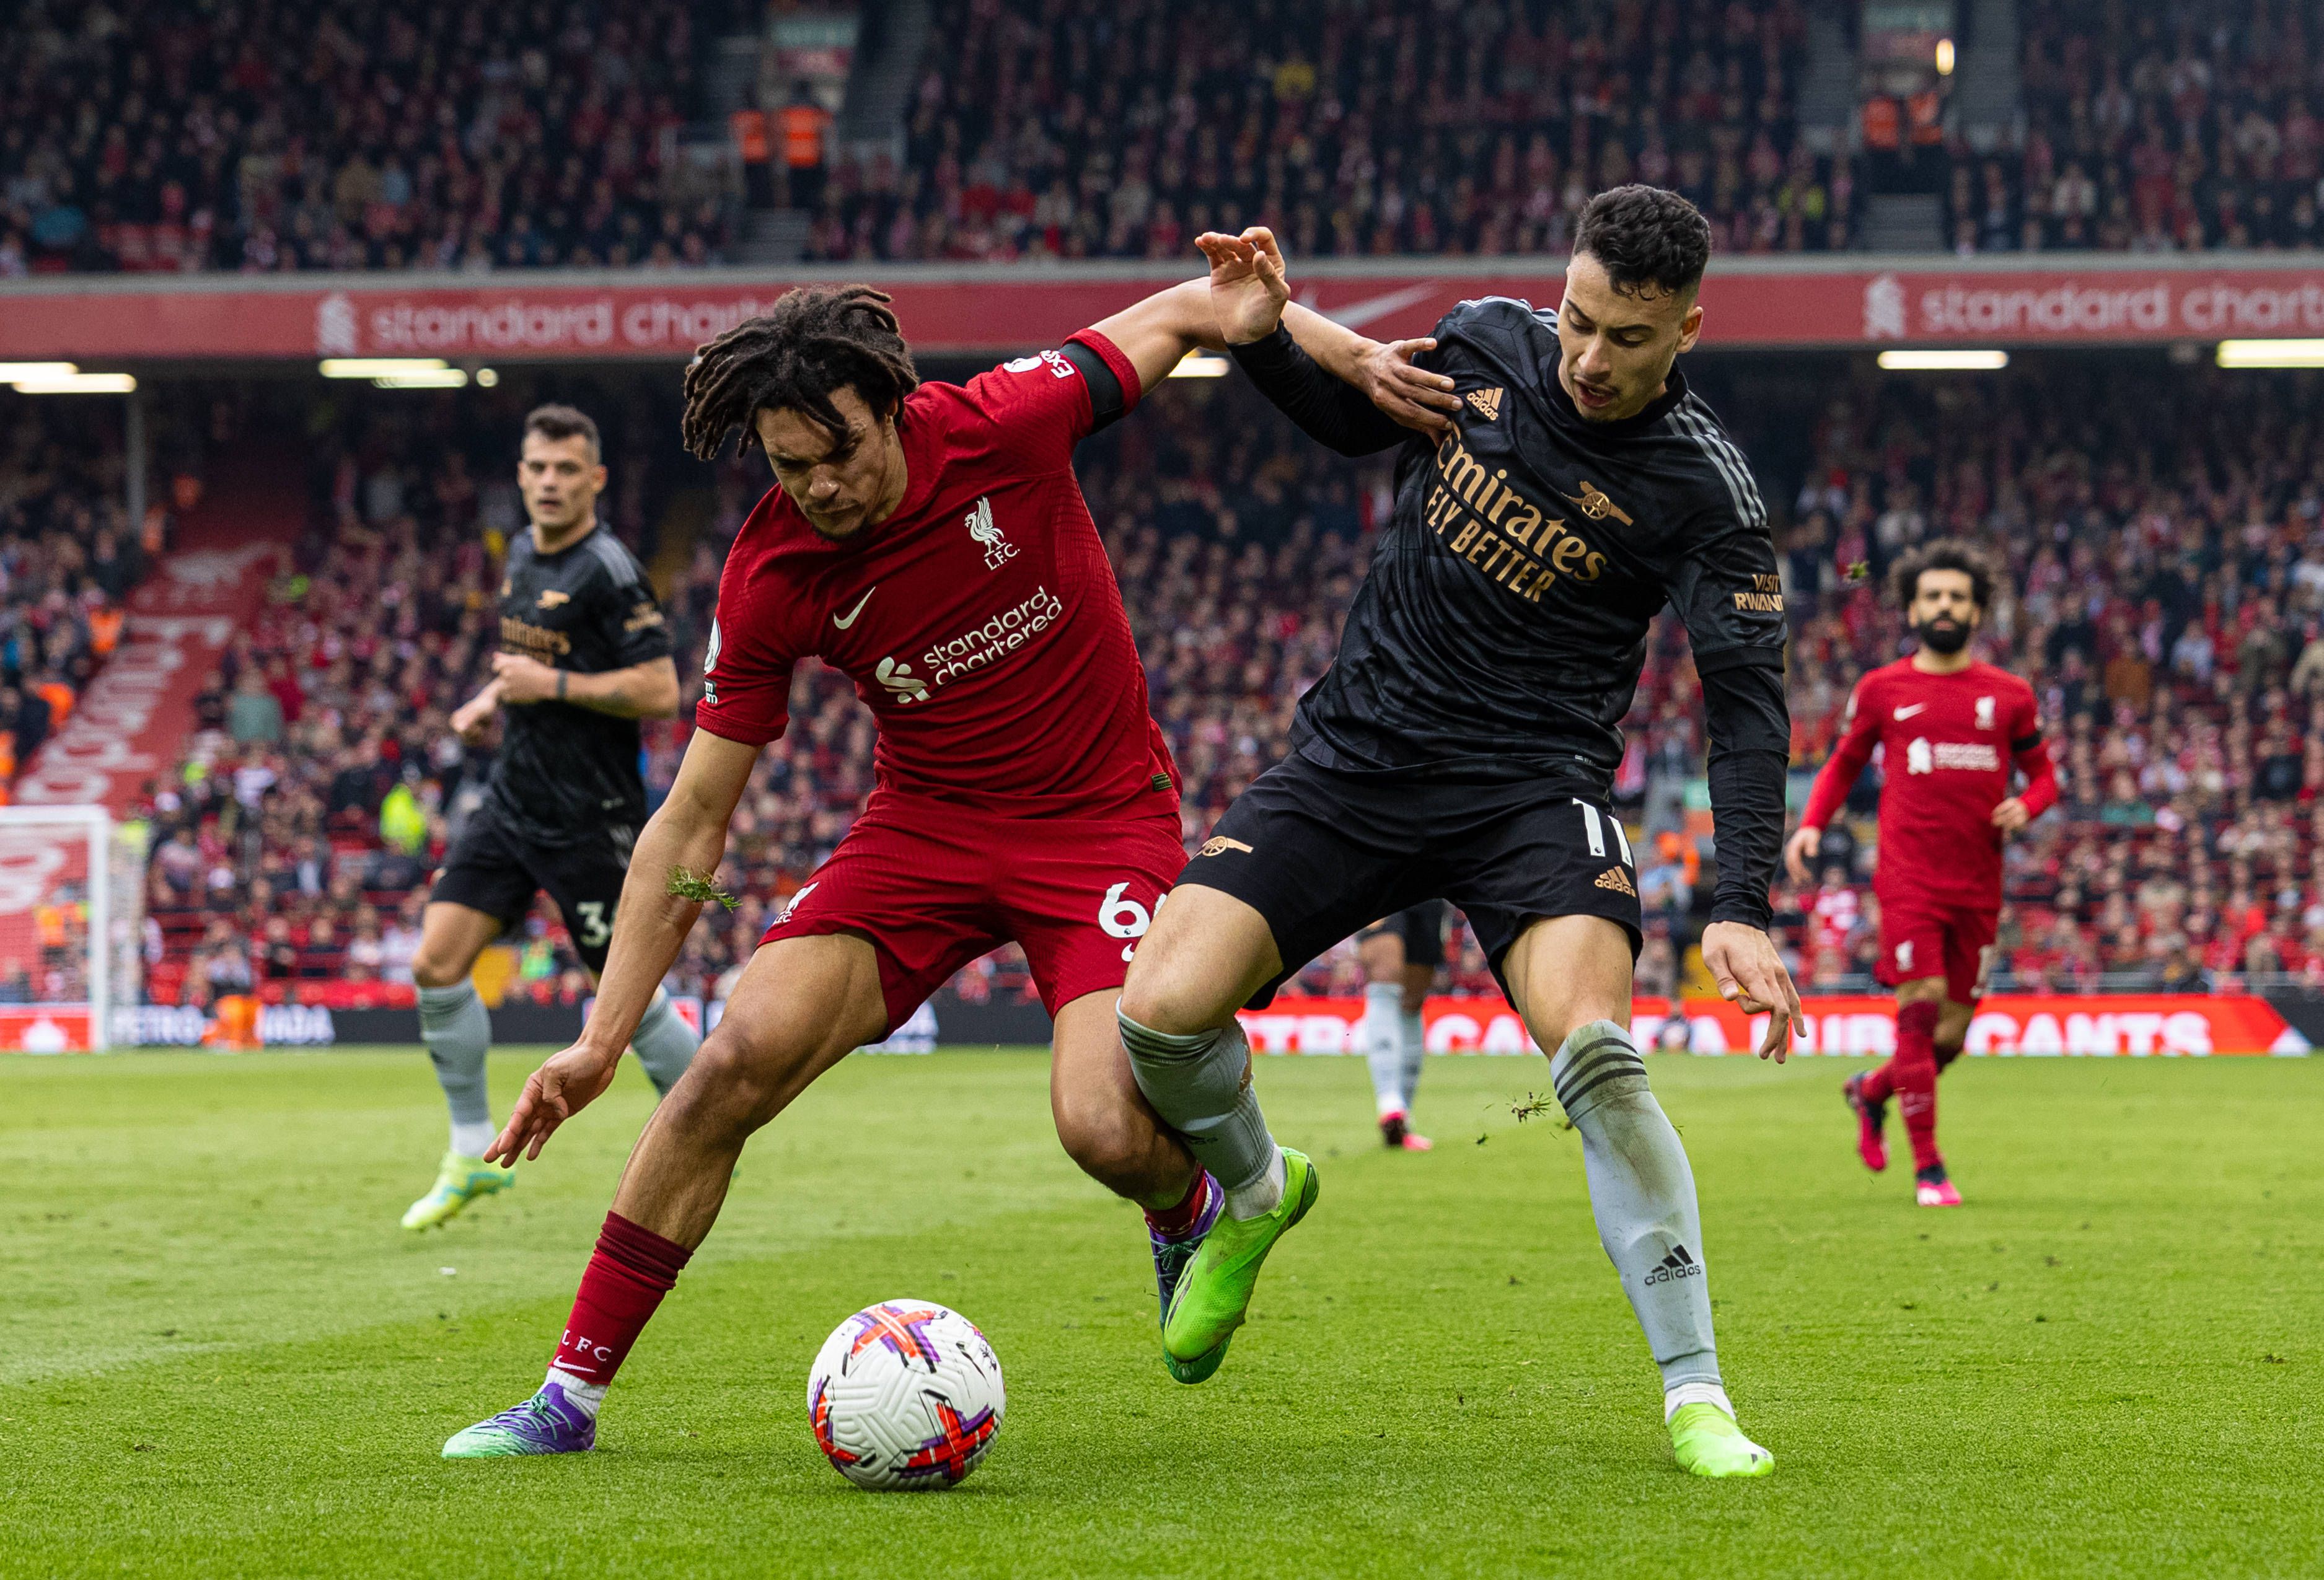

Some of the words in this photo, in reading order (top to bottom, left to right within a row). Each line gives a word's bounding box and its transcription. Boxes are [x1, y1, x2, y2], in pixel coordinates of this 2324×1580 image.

[374, 300, 614, 345] standard
[1921, 283, 2169, 331] standard
[1466, 392, 1499, 421] adidas
[1424, 483, 1463, 535] FLY
[1450, 518, 1556, 603] BETTER
[1751, 574, 1780, 593] VISIT
[923, 585, 1049, 670] standard
[935, 595, 1063, 686] chartered
[1572, 797, 1633, 868] 11
[1594, 878, 1637, 898] adidas
[1644, 1265, 1701, 1286] adidas
